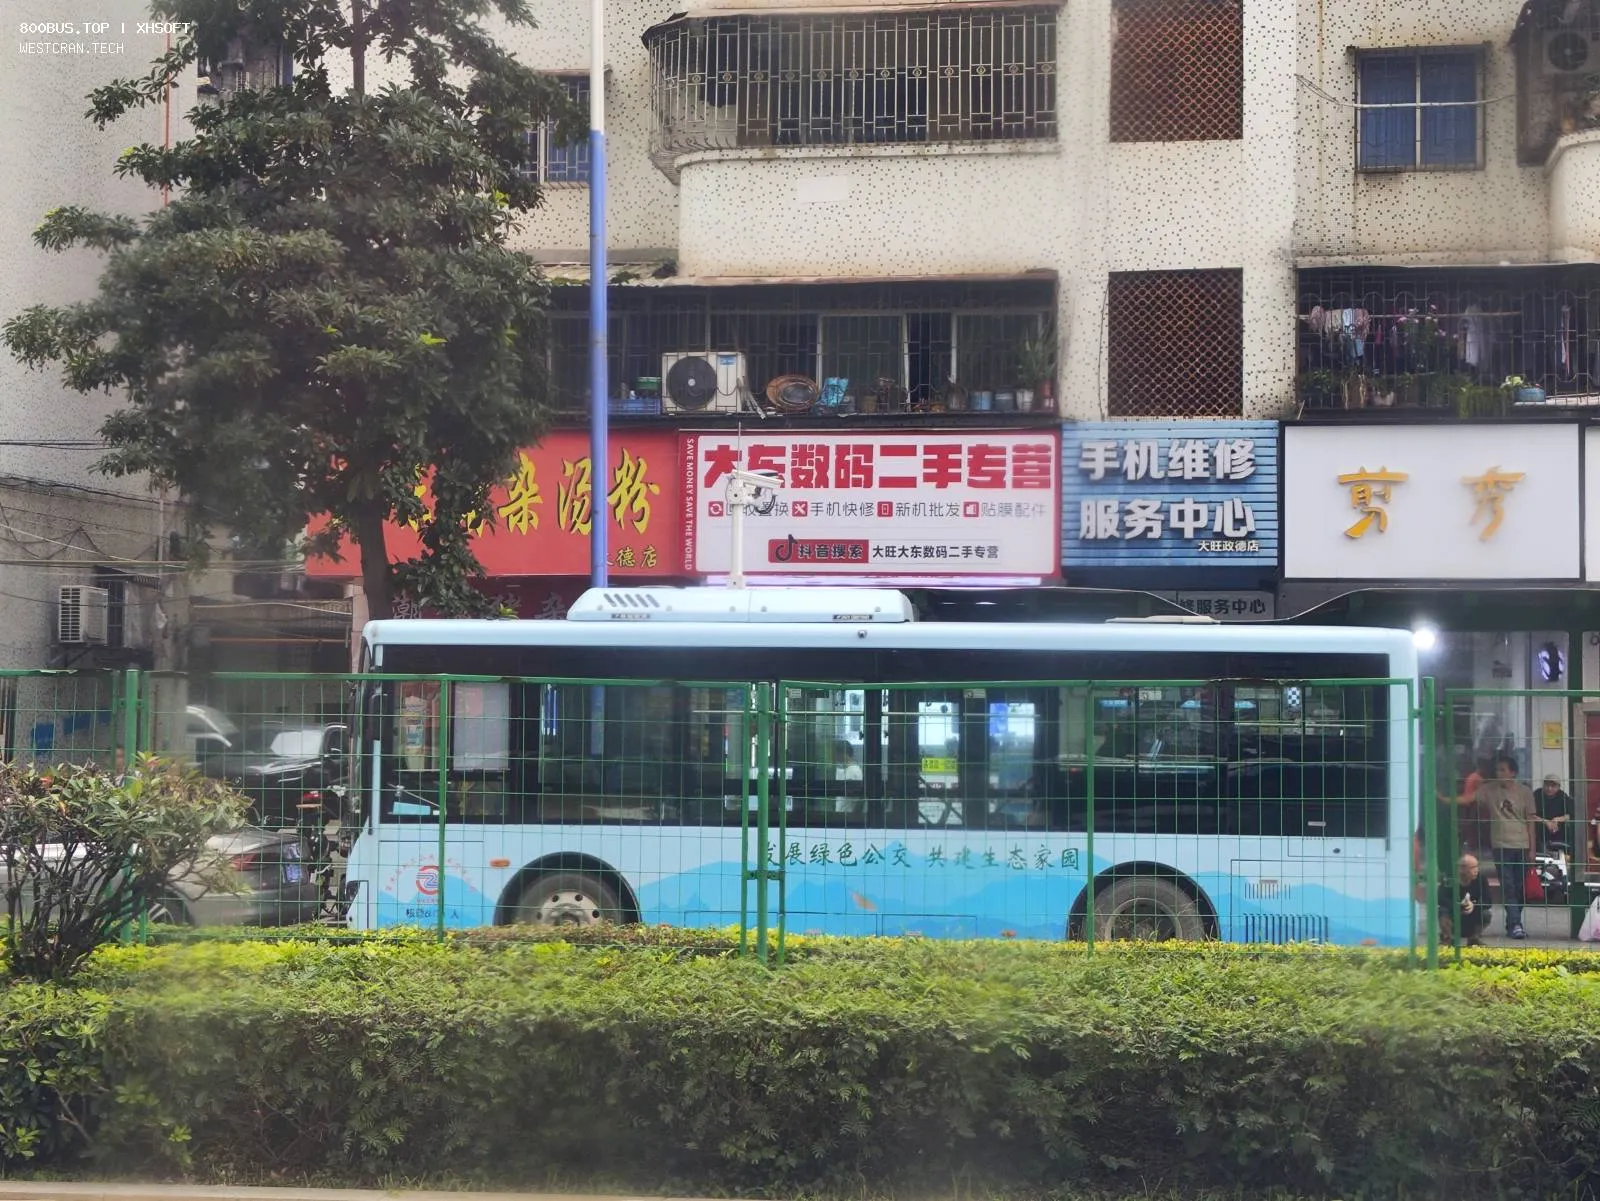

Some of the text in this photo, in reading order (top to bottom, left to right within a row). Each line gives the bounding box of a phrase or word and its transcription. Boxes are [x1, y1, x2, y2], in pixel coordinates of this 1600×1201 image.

[703, 443, 1052, 489] 大东数码二手专营
[1078, 438, 1257, 481] 手机维修
[684, 438, 694, 570] SAVE MONEY SAVE THE WORLD
[809, 501, 876, 517] 手机快修
[895, 501, 961, 517] 新机批发
[980, 501, 1047, 518] 贴膜配件
[1078, 497, 1257, 540] 服务中心
[605, 544, 657, 568] 德店
[798, 545, 1000, 559] 抖音搜索 大旺大东数码二手专营
[1198, 540, 1260, 552] 大旺政德店
[926, 844, 1079, 871] 共建生态家园
